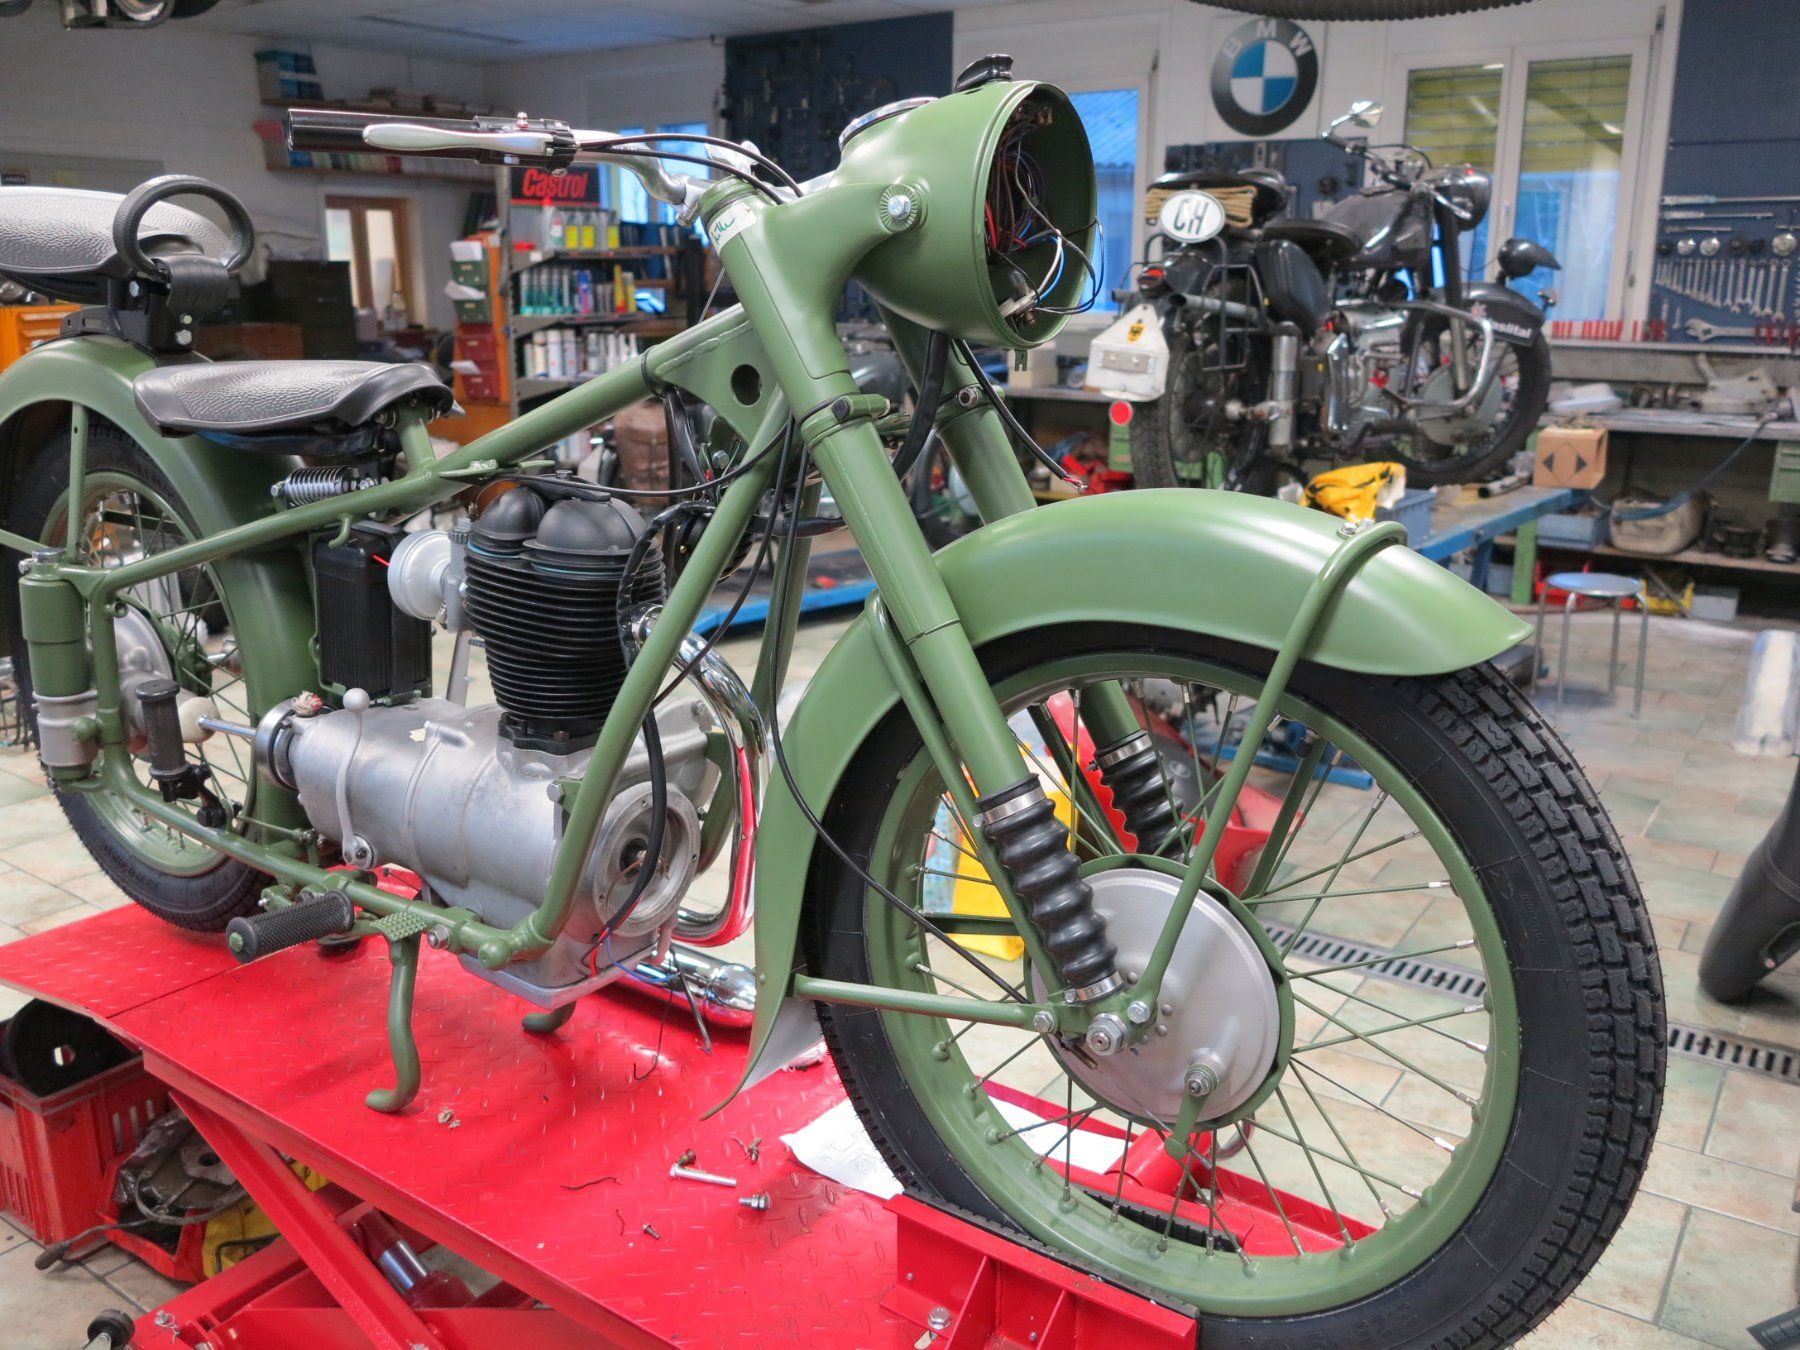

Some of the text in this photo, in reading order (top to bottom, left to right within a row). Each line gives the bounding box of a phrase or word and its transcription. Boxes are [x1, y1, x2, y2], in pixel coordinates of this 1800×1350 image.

[1221, 18, 1312, 58] BMW
[522, 168, 588, 198] Castrol
[1173, 198, 1209, 235] CH
